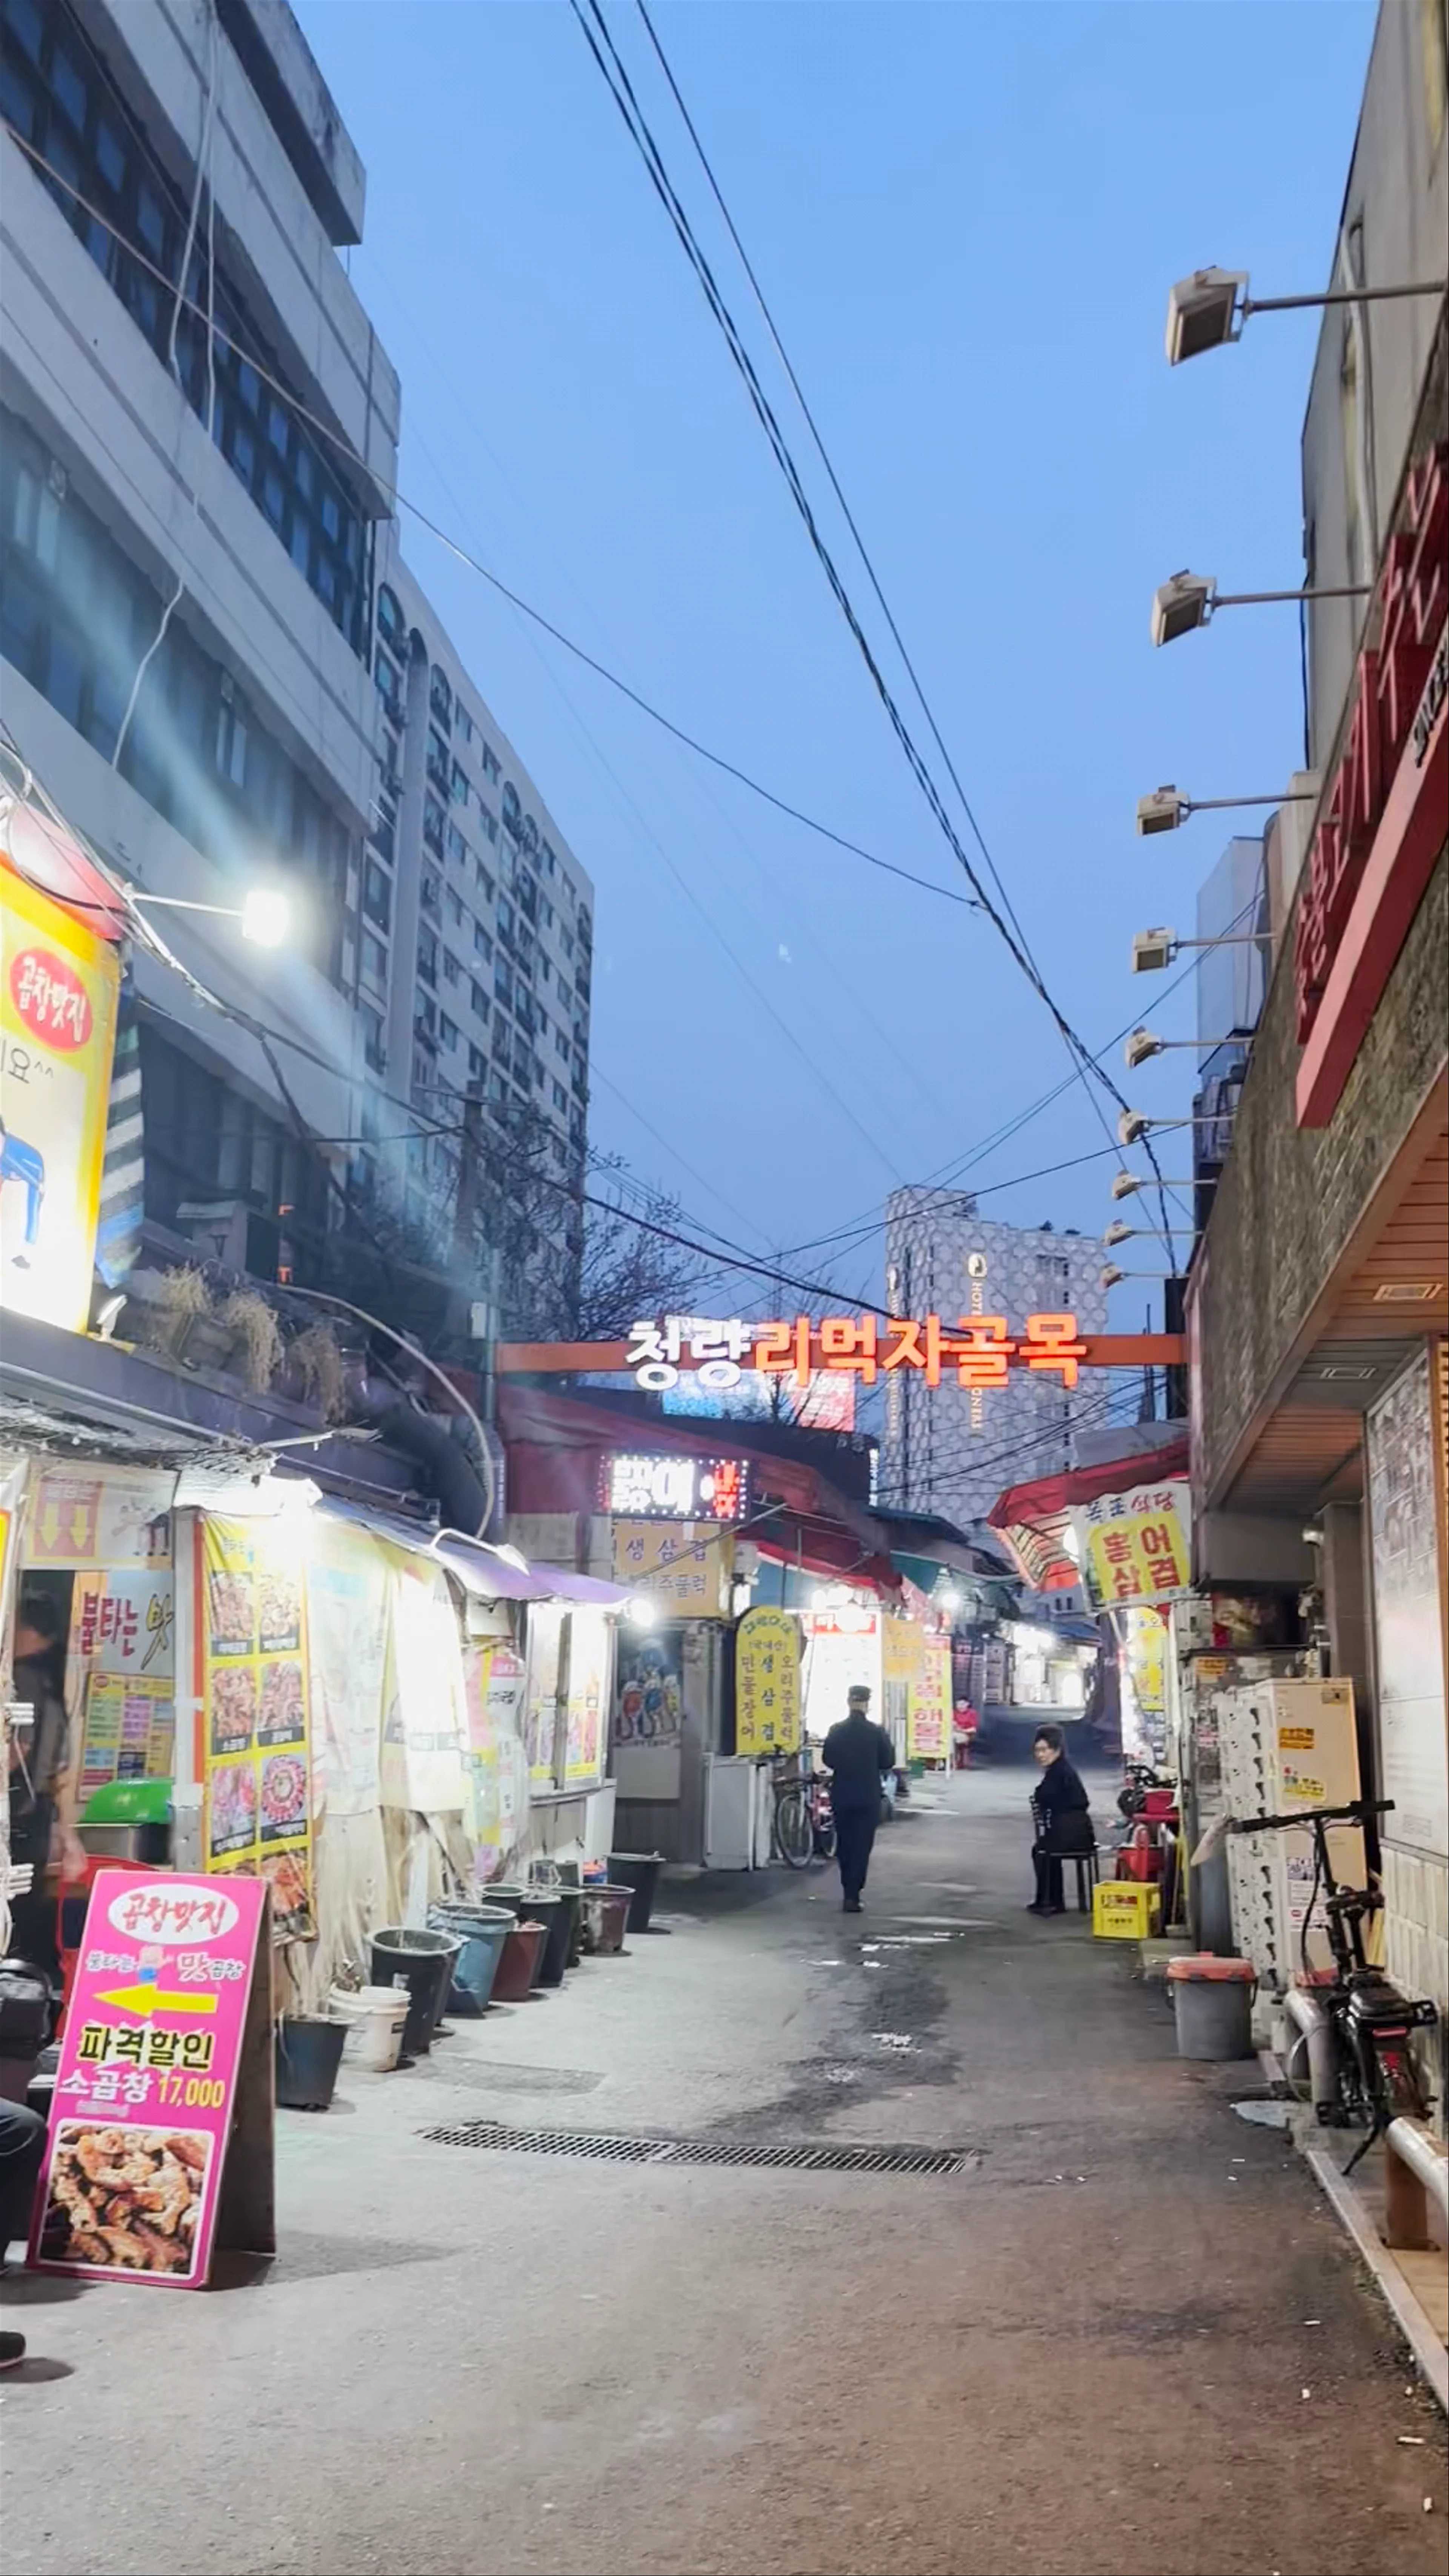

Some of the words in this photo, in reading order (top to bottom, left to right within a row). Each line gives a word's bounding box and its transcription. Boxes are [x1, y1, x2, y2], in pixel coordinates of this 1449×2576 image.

[79, 2026, 212, 2069] 파격할인
[58, 2069, 152, 2103] 소곱창
[158, 2076, 226, 2108] 17,000
